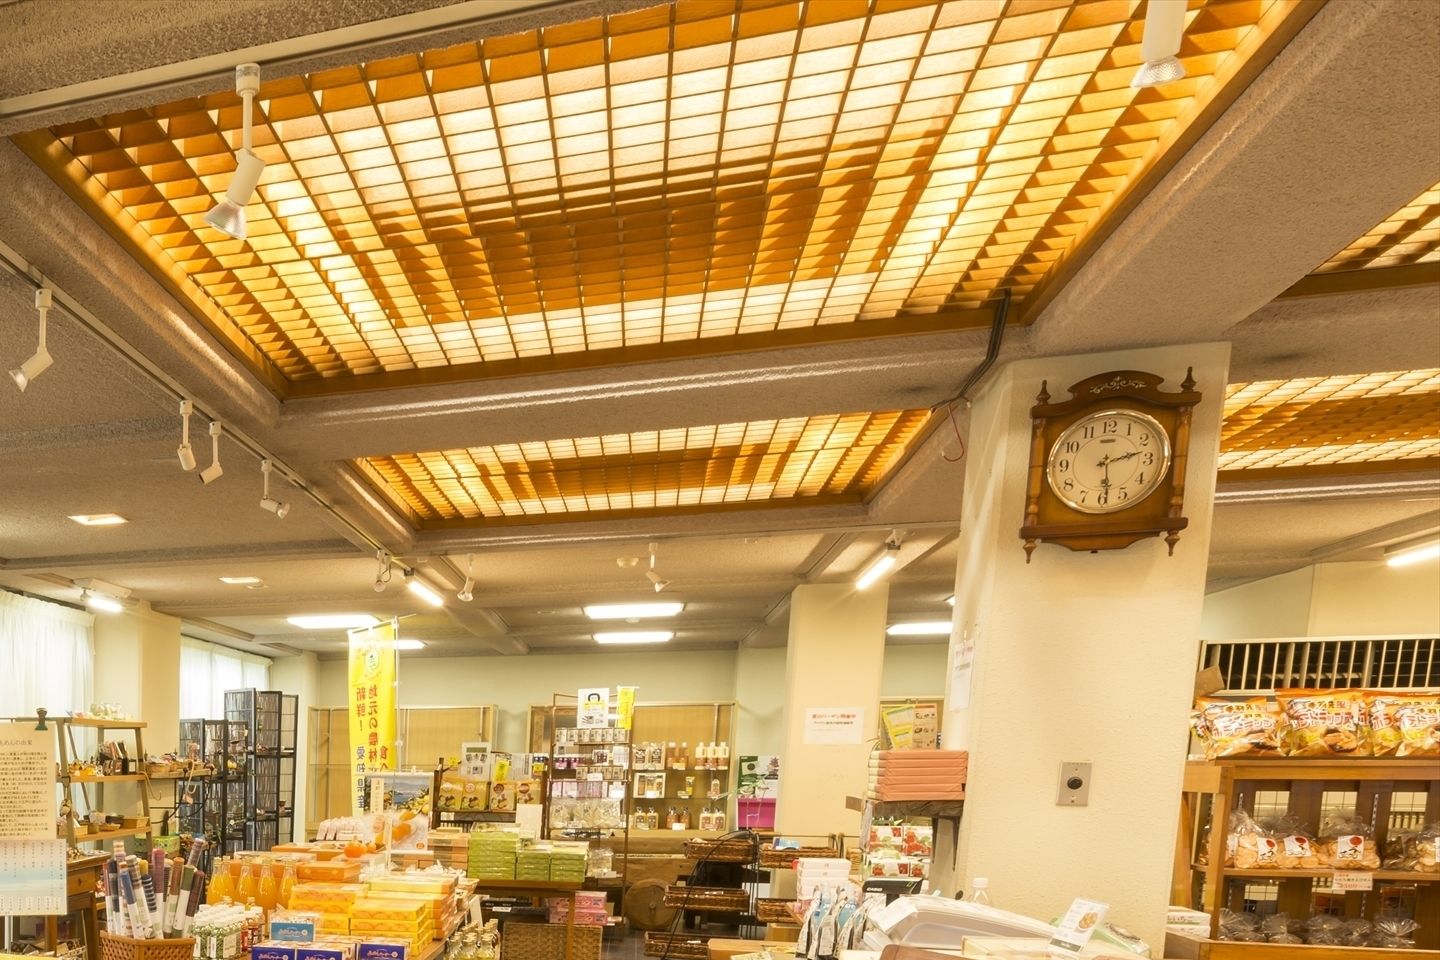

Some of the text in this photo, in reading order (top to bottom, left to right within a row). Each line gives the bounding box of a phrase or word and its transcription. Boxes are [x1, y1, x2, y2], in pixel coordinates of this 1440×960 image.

[1083, 427, 1094, 438] 11
[1103, 421, 1117, 434] 12
[1127, 423, 1132, 436] 1
[1139, 433, 1149, 446] 2
[1066, 441, 1079, 453] 10
[1142, 453, 1154, 465] 3
[1059, 460, 1069, 472] 9
[1134, 472, 1144, 484] 4
[1063, 478, 1074, 491] 8
[1080, 490, 1088, 503] 7
[1097, 493, 1108, 504] 6
[1117, 487, 1128, 500] 5
